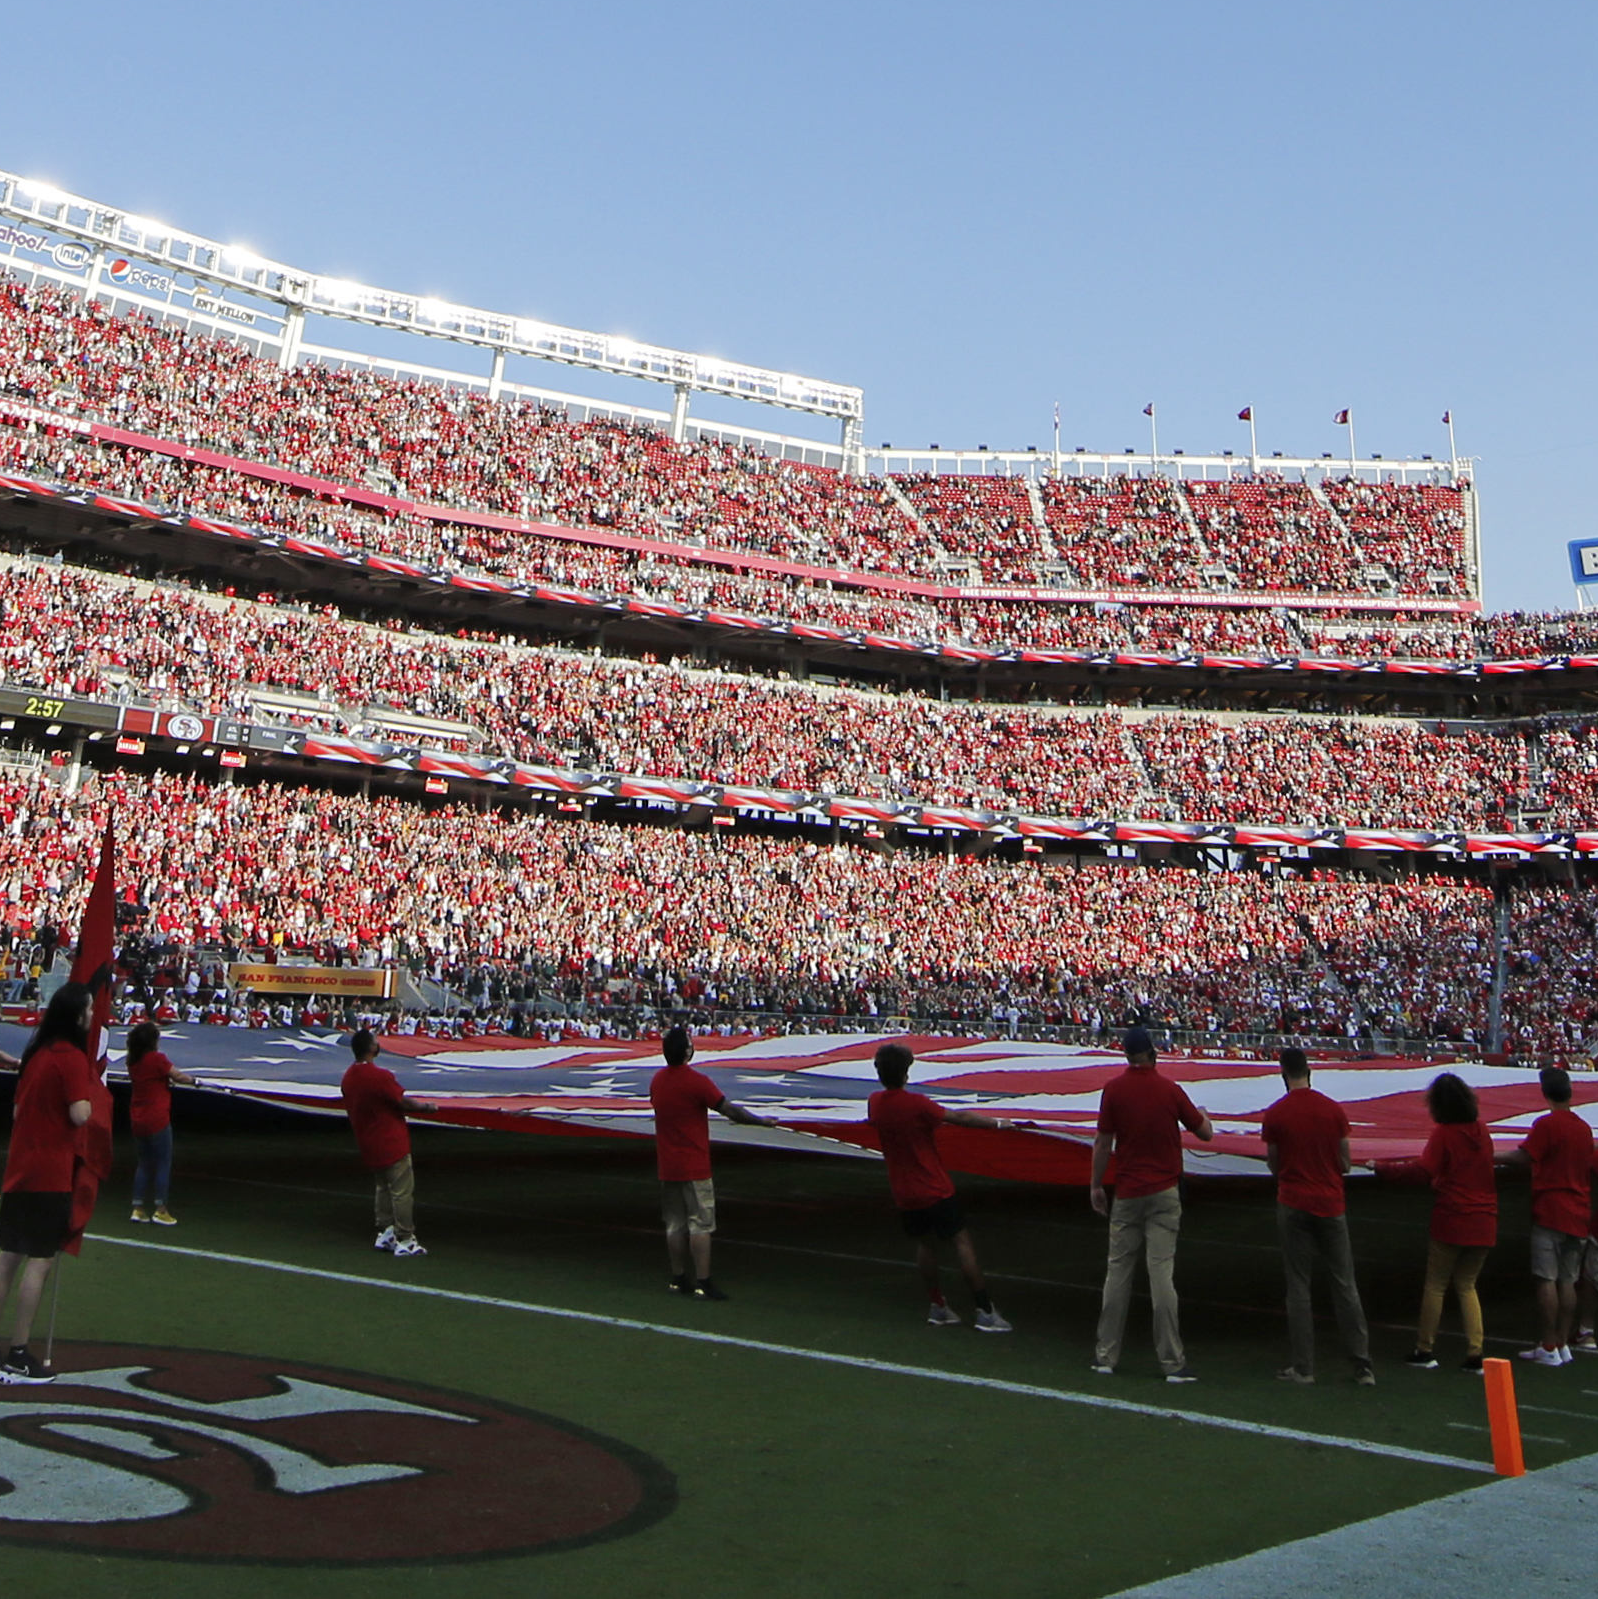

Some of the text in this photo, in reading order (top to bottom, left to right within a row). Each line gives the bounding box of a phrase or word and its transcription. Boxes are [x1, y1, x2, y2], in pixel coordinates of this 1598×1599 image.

[131, 267, 172, 292] pepsi
[959, 588, 980, 597] FREE
[1036, 591, 1058, 599] NEED
[1058, 592, 1110, 600] ASSISTANCE?
[1113, 592, 1133, 601] TEXT
[1134, 593, 1179, 602] "SUPPORT"
[1180, 594, 1191, 603] TO
[1282, 596, 1316, 606] INCLUDE
[1317, 598, 1340, 607] ISSUE,
[1343, 599, 1398, 609] DESCRIPTION,
[1400, 600, 1417, 609] AND
[1417, 601, 1461, 610] LOCATION.
[25, 696, 66, 719] 2:57
[237, 973, 265, 983] SAN
[268, 974, 338, 986] FRANCISCO
